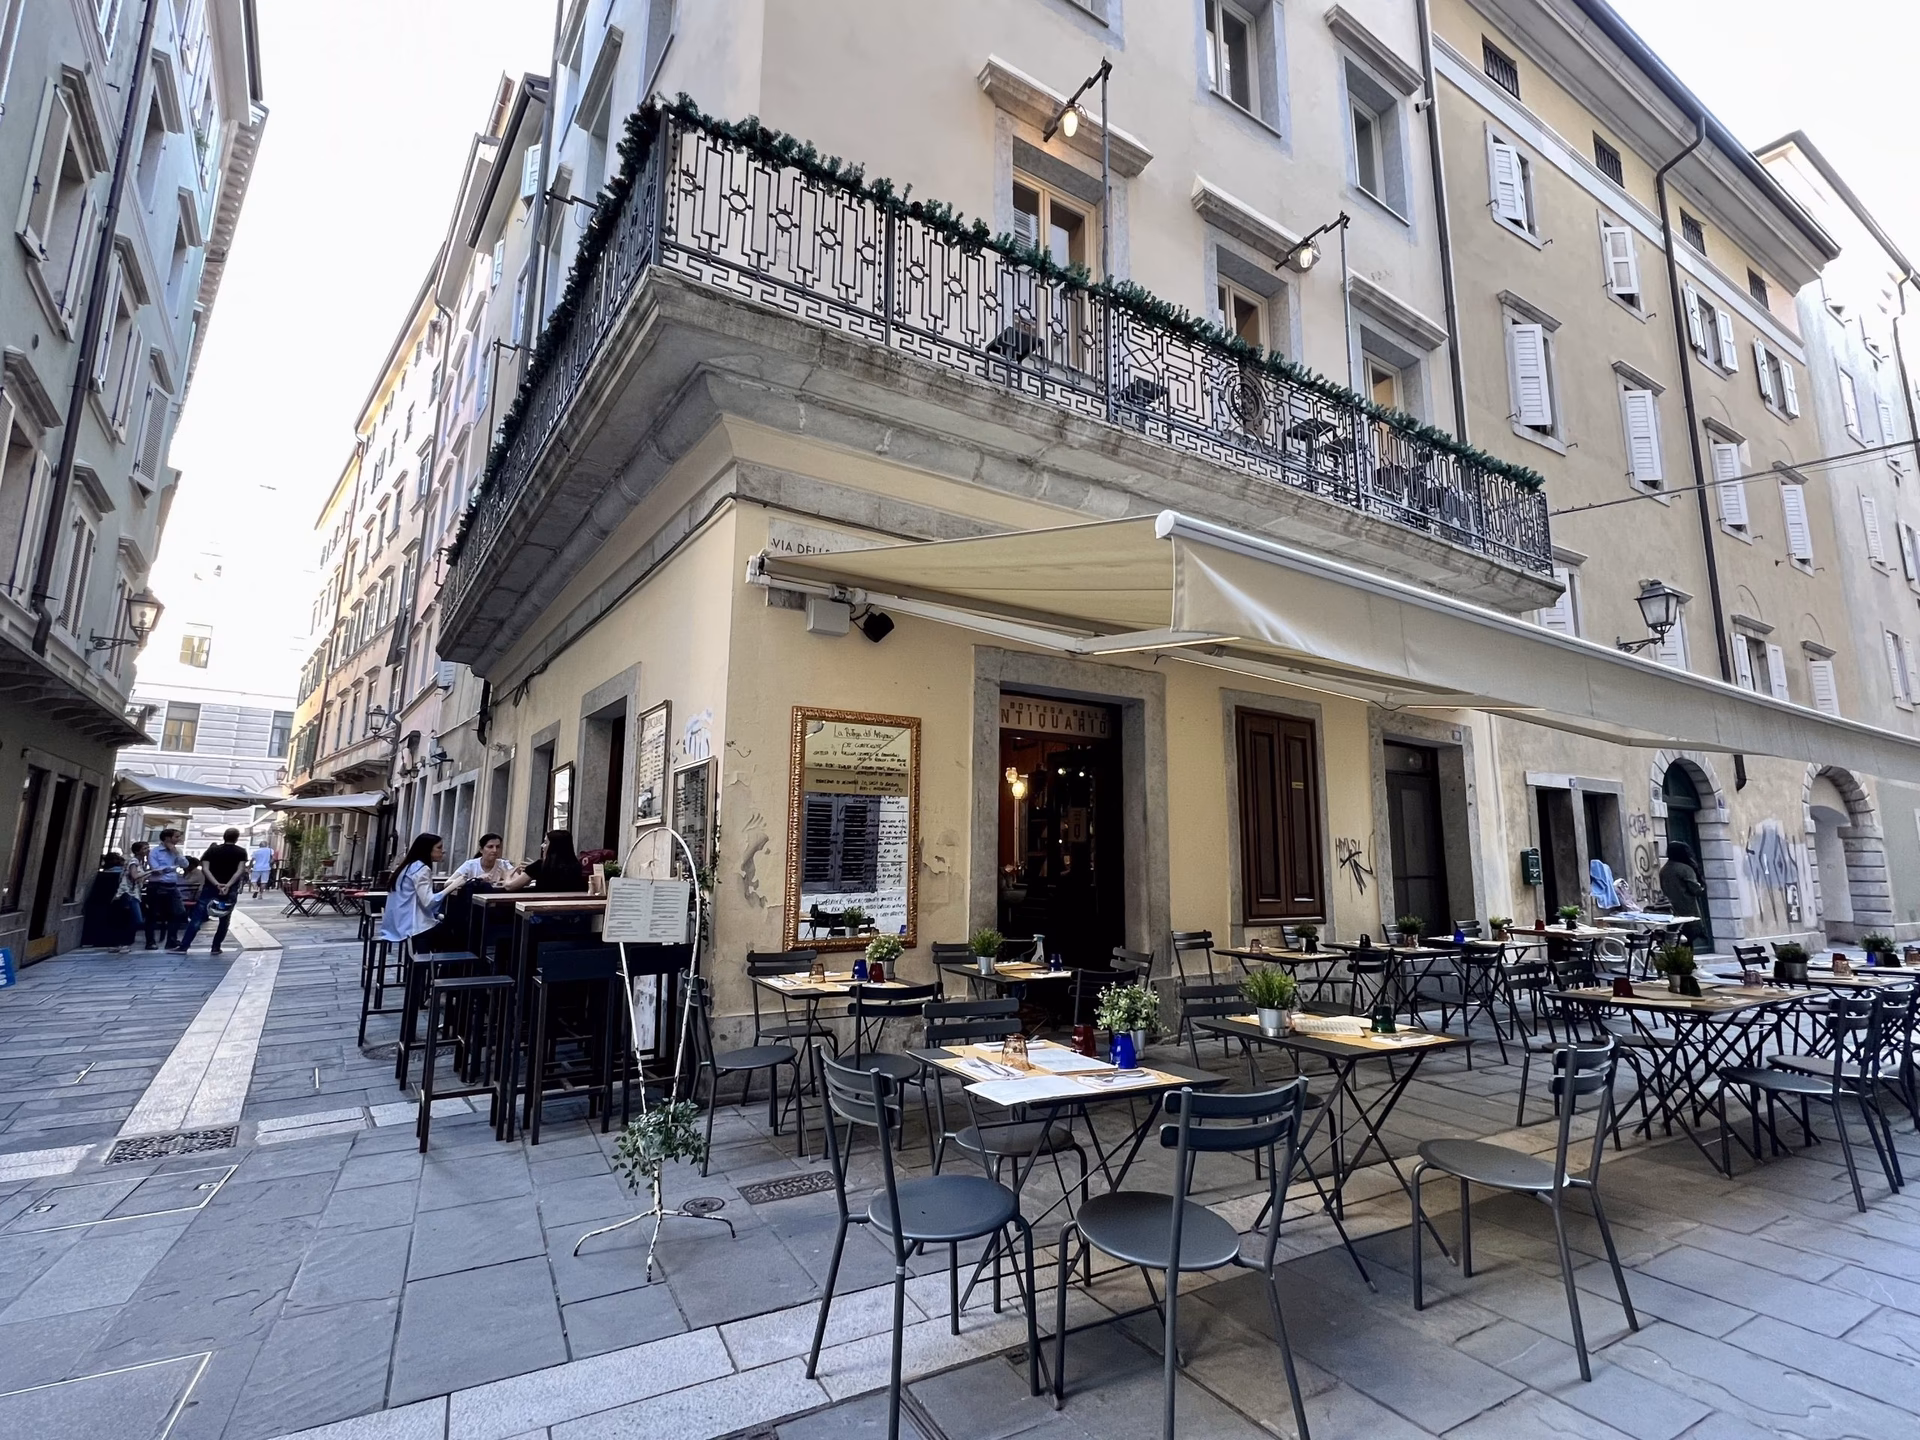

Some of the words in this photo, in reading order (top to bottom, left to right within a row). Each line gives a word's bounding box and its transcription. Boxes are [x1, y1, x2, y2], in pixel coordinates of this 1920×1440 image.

[772, 538, 793, 552] VIA
[797, 543, 830, 554] DEL
[1010, 702, 1063, 715] BOTTEGA
[1001, 709, 1106, 734] NTIQUARIO
